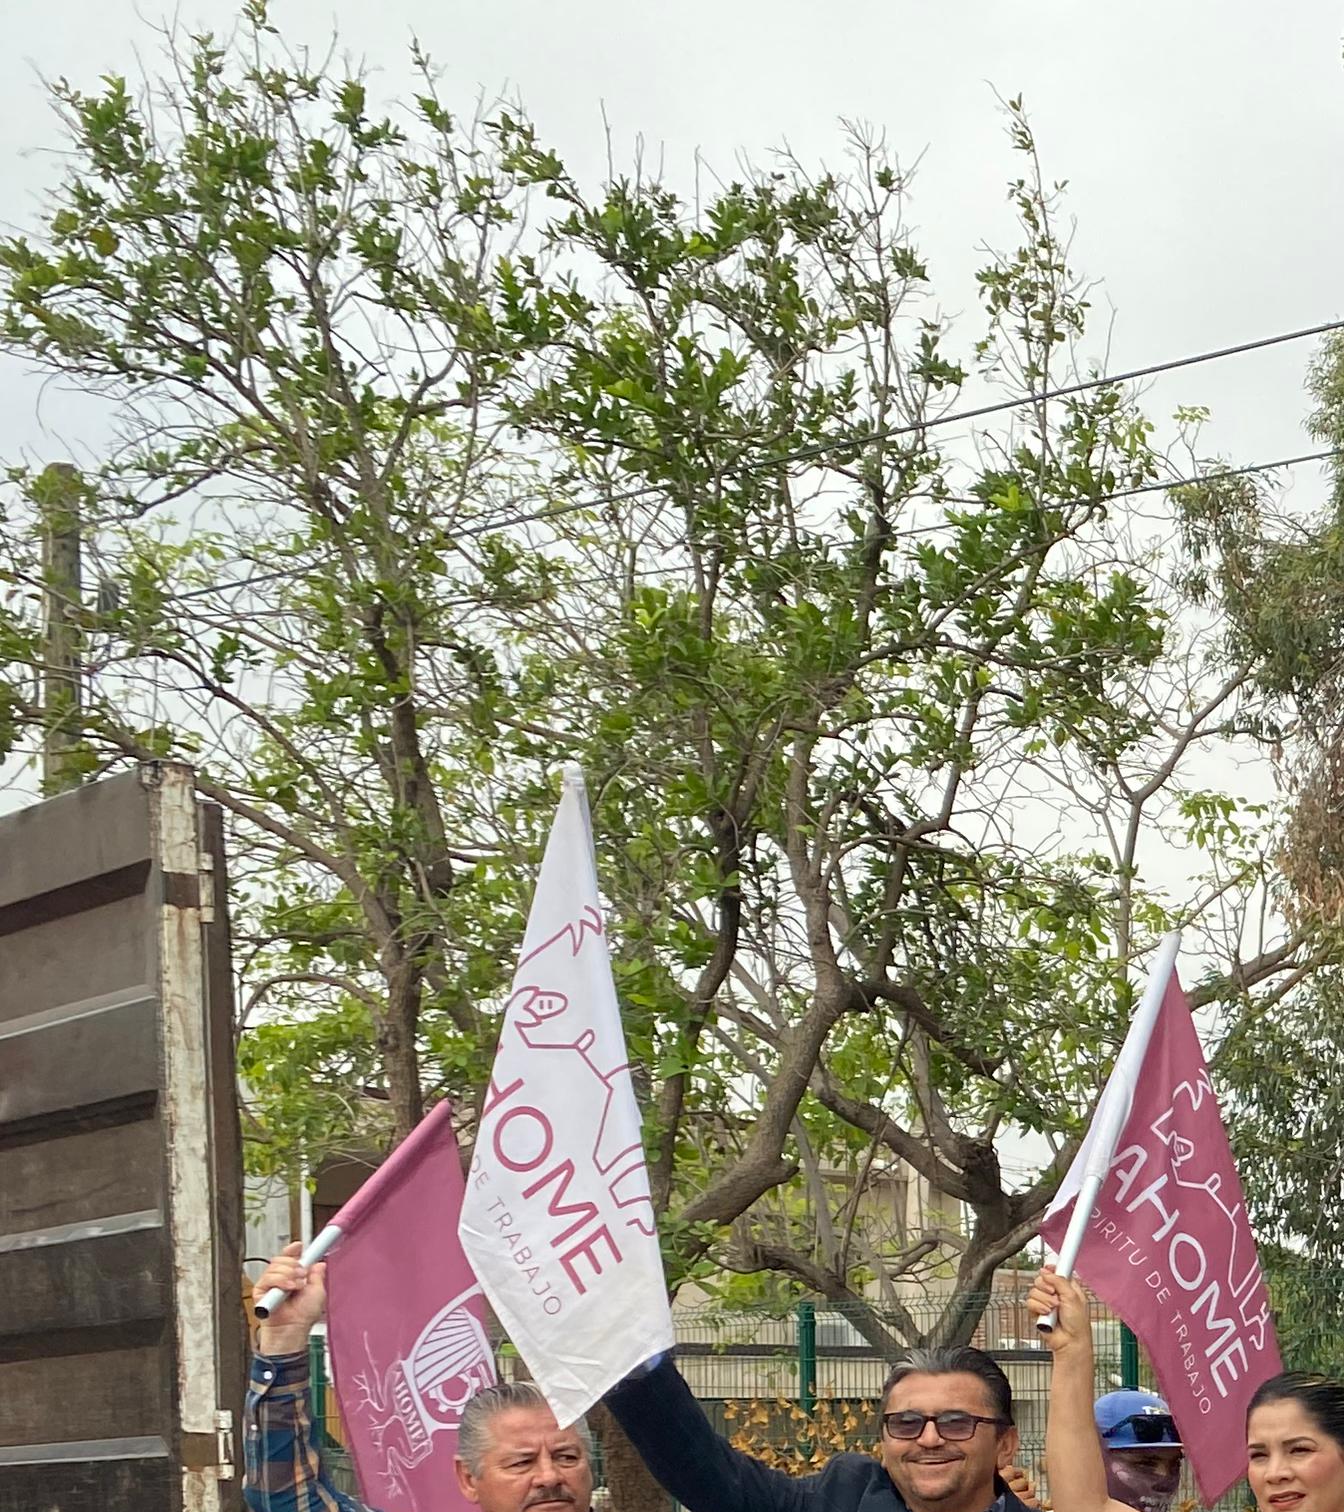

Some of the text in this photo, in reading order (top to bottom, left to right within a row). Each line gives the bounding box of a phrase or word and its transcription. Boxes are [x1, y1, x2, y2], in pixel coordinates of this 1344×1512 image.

[482, 1077, 623, 1295] HOME
[486, 1195, 562, 1316] TRABAJO
[1110, 1144, 1249, 1399] AHOME
[1145, 1271, 1172, 1305] DE
[1170, 1311, 1212, 1415] TRABAJO
